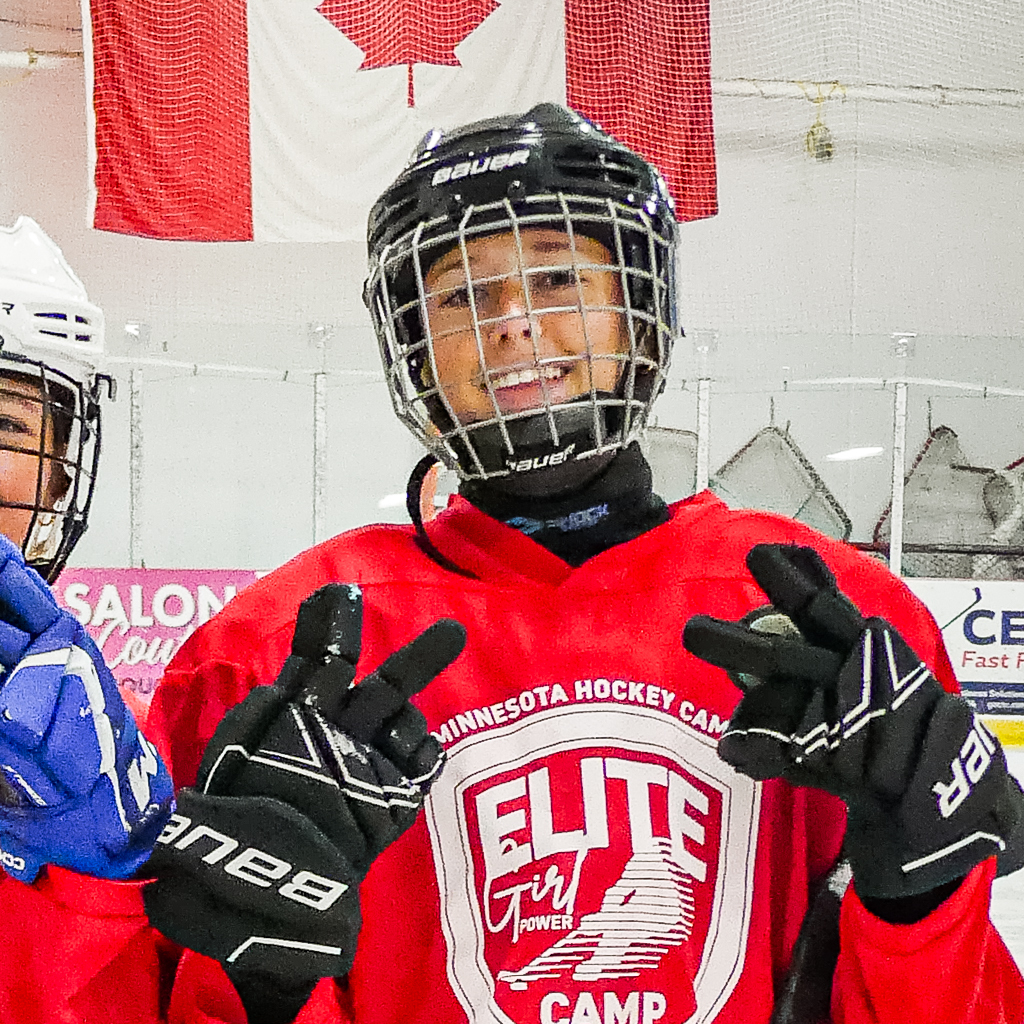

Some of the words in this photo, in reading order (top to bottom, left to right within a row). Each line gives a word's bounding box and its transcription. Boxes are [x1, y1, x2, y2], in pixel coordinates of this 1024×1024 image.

[431, 149, 530, 187] BAUER
[63, 583, 237, 628] SALON
[961, 650, 1009, 669] Fast
[430, 683, 569, 744] MINNESOTA
[574, 678, 676, 711] HOCKEY
[678, 700, 730, 734] CAM
[475, 757, 710, 882] ELITE
[156, 813, 349, 912] BAUE
[520, 913, 574, 934] POWER
